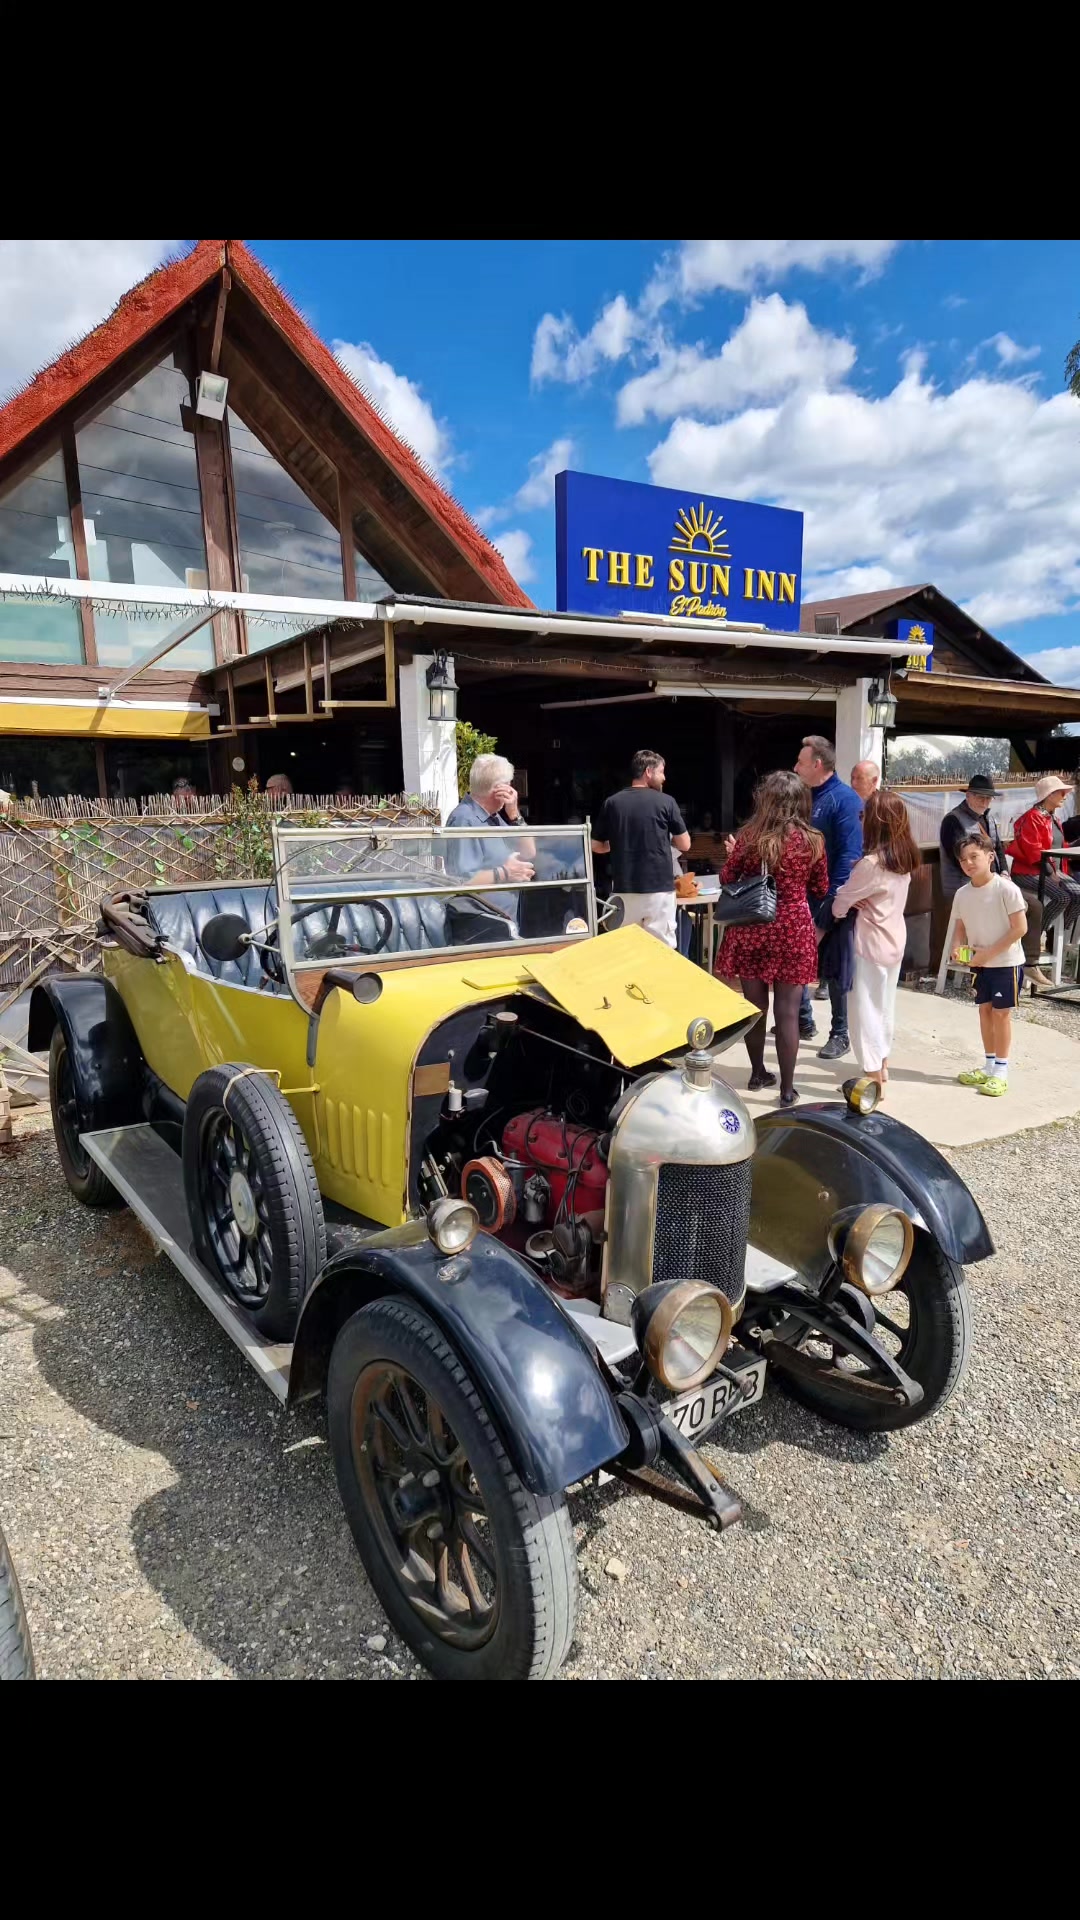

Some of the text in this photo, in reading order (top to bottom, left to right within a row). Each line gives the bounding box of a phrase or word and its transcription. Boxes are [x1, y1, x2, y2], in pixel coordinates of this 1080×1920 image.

[583, 547, 797, 603] THE SUN INN
